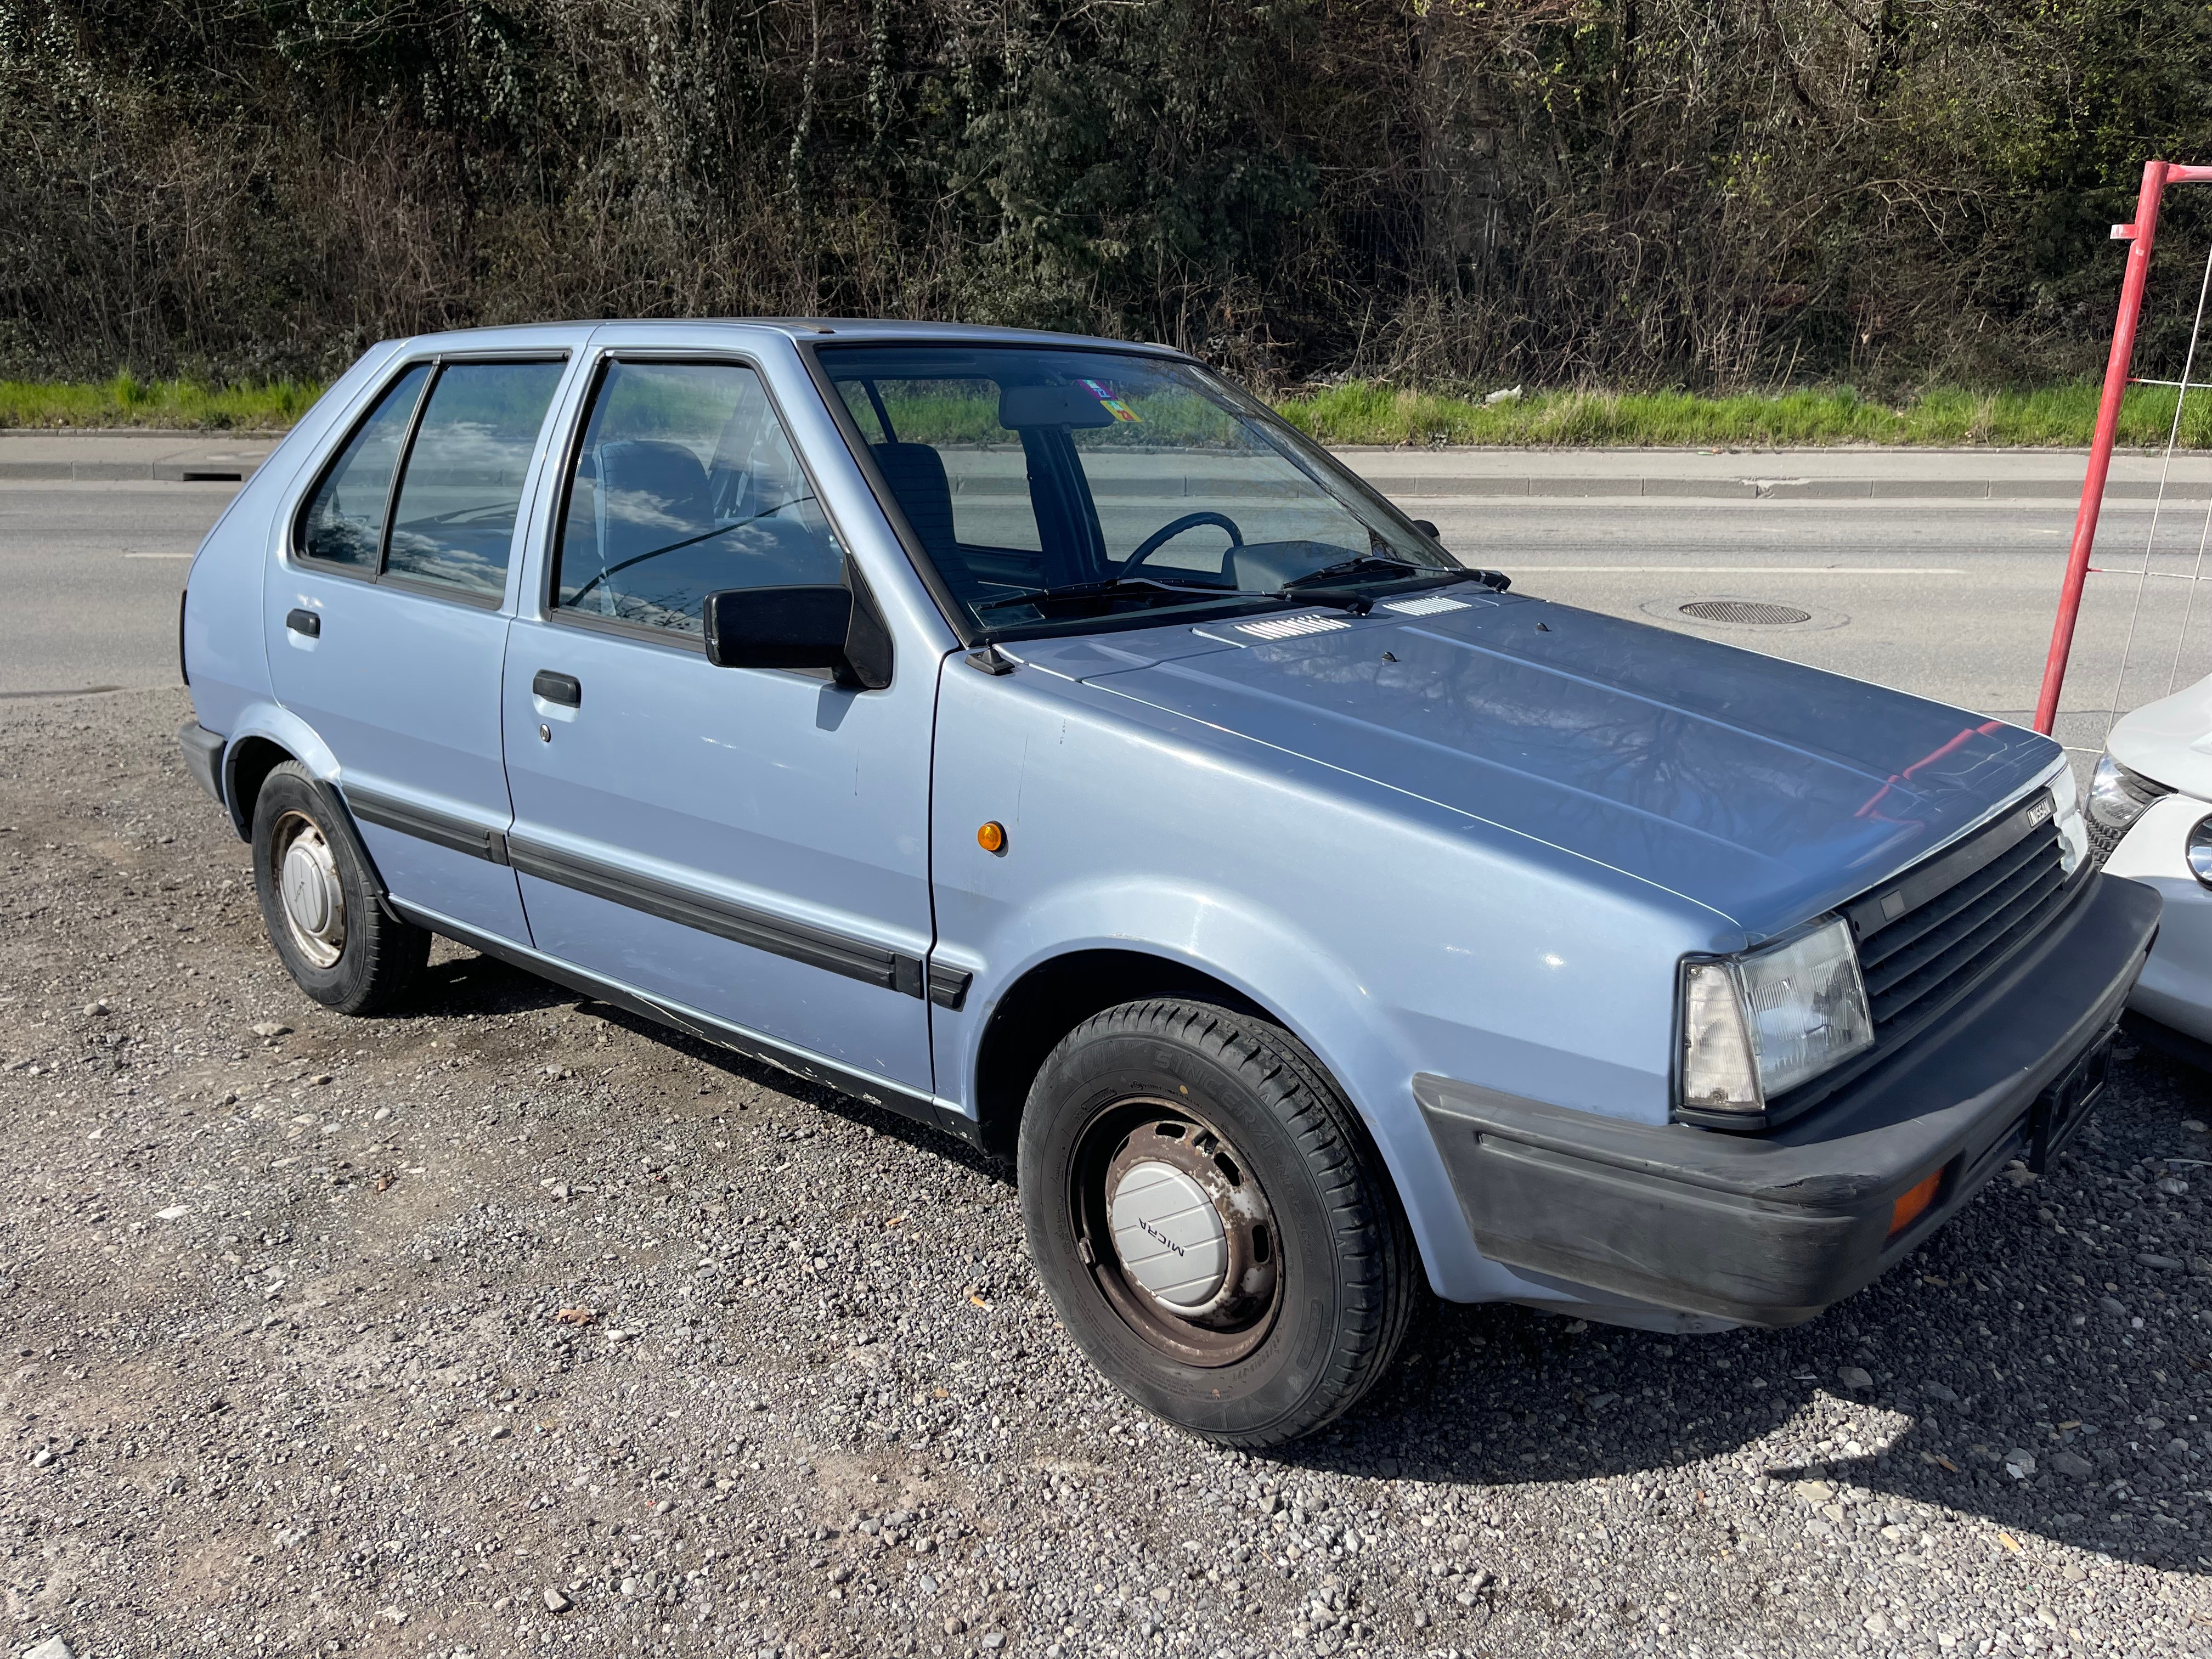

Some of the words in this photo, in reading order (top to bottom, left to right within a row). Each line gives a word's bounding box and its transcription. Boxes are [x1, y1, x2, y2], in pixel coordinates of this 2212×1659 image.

[2029, 800, 2050, 825] NISSAN
[1154, 1049, 1276, 1150] SINCERA
[1138, 1217, 1184, 1257] MICRA
